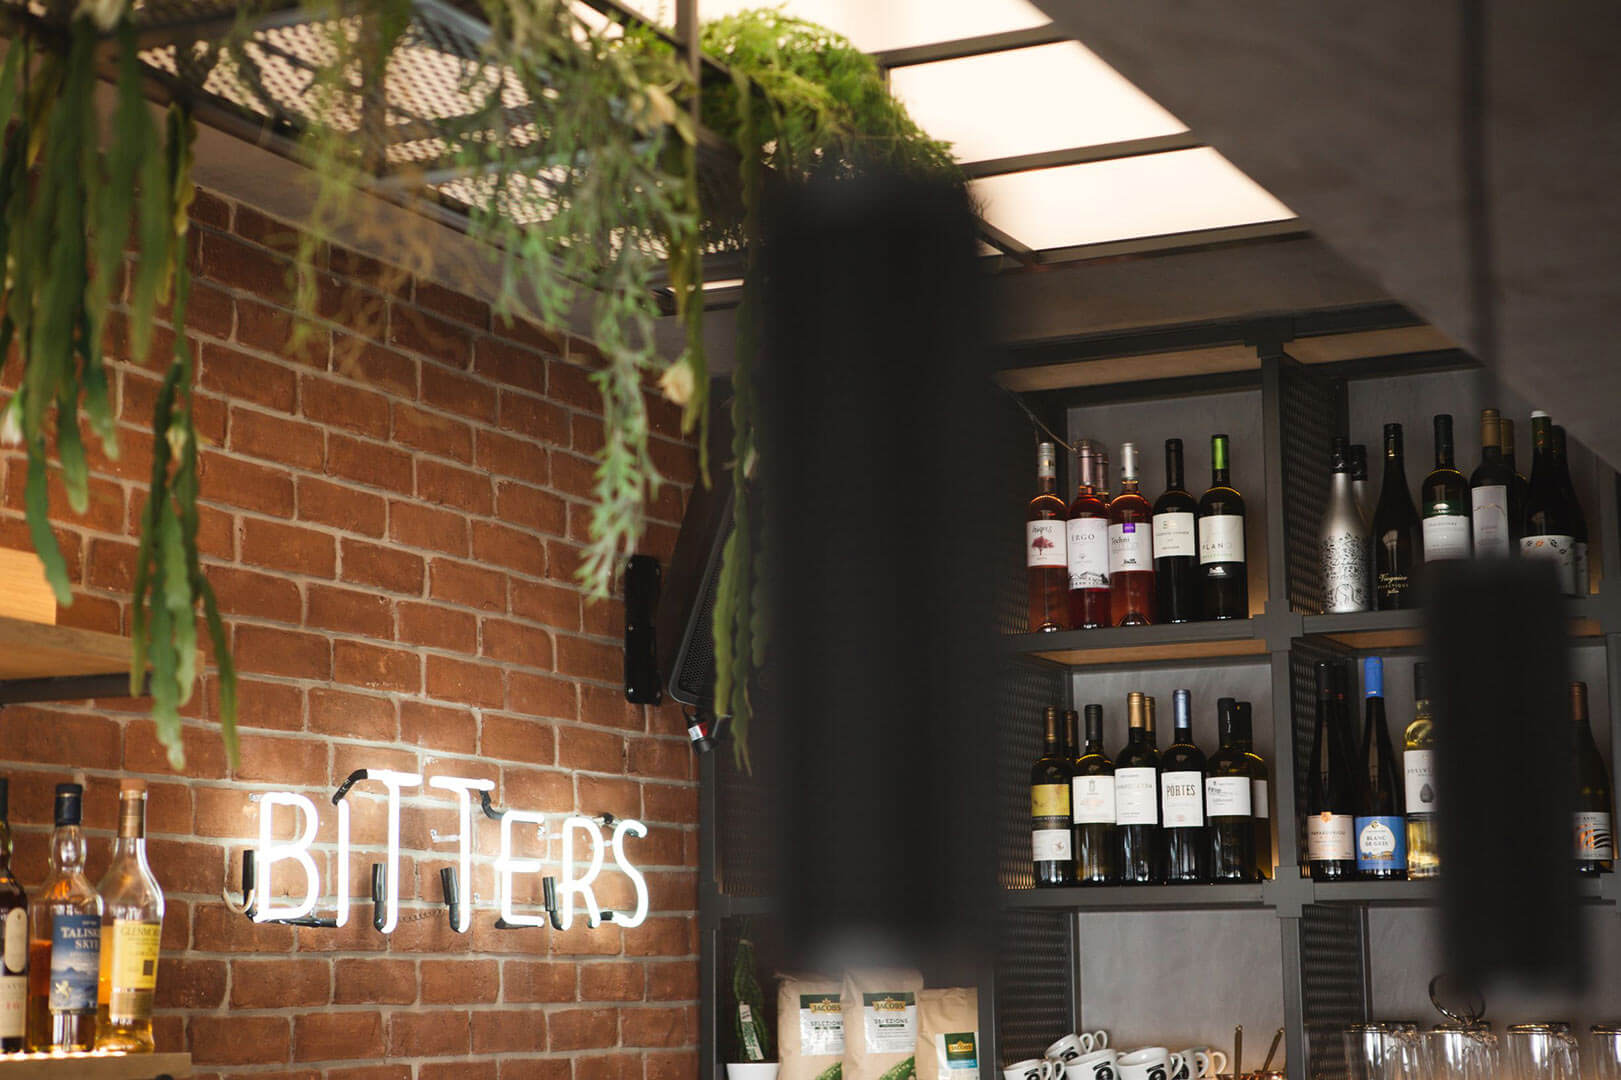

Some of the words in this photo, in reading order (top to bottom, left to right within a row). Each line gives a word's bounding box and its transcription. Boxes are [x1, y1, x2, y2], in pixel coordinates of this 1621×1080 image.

[1166, 784, 1196, 797] PORTES
[253, 768, 649, 934] BITTERS
[811, 1004, 842, 1013] JACOBS
[874, 1002, 904, 1011] JACOBS
